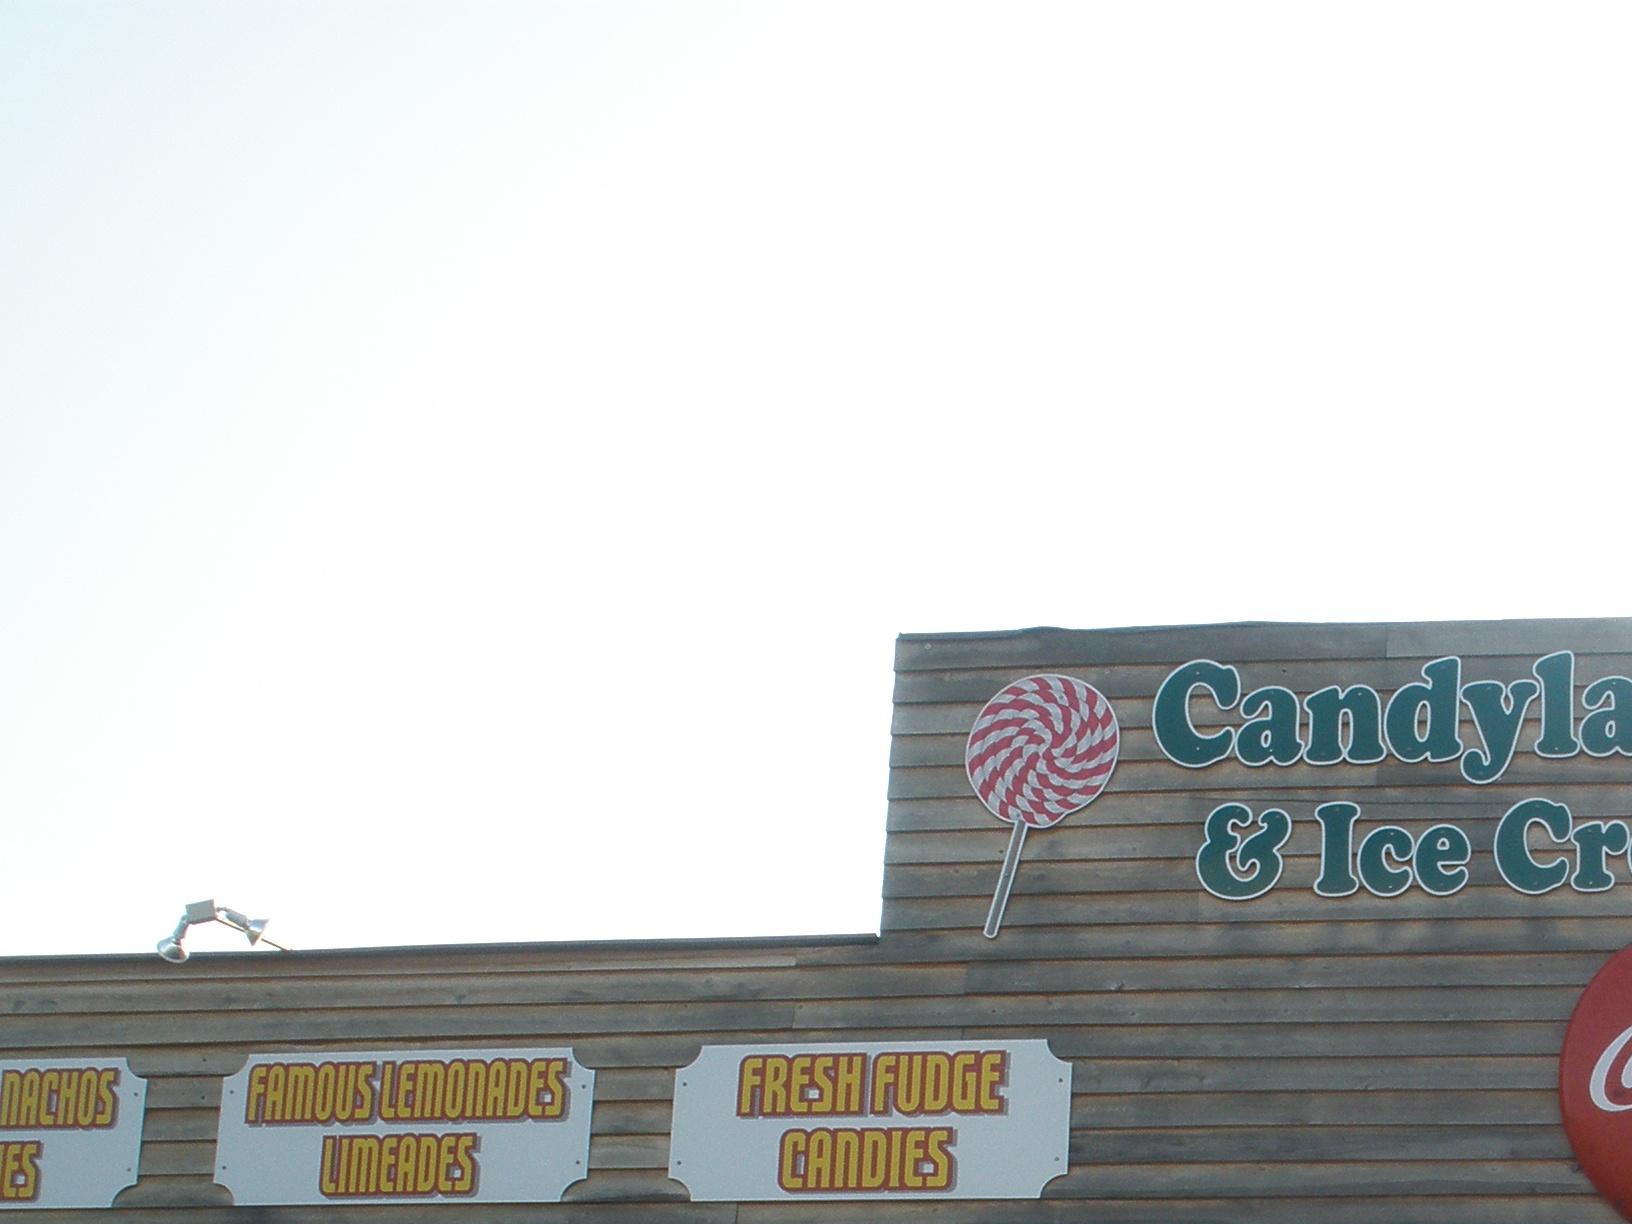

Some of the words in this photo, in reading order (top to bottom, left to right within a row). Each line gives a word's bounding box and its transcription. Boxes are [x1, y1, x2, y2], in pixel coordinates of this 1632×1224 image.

[1197, 802, 1291, 900] &
[1314, 801, 1471, 896] Ice
[0, 1067, 118, 1128] NACHOS
[245, 1061, 379, 1124] FAMOUS
[379, 1058, 569, 1121] LEMONADES
[736, 1052, 868, 1117] FRESH
[870, 1050, 1006, 1115] FUDGE
[320, 1133, 479, 1198] LIMEADES
[777, 1127, 955, 1192] CANDIES
